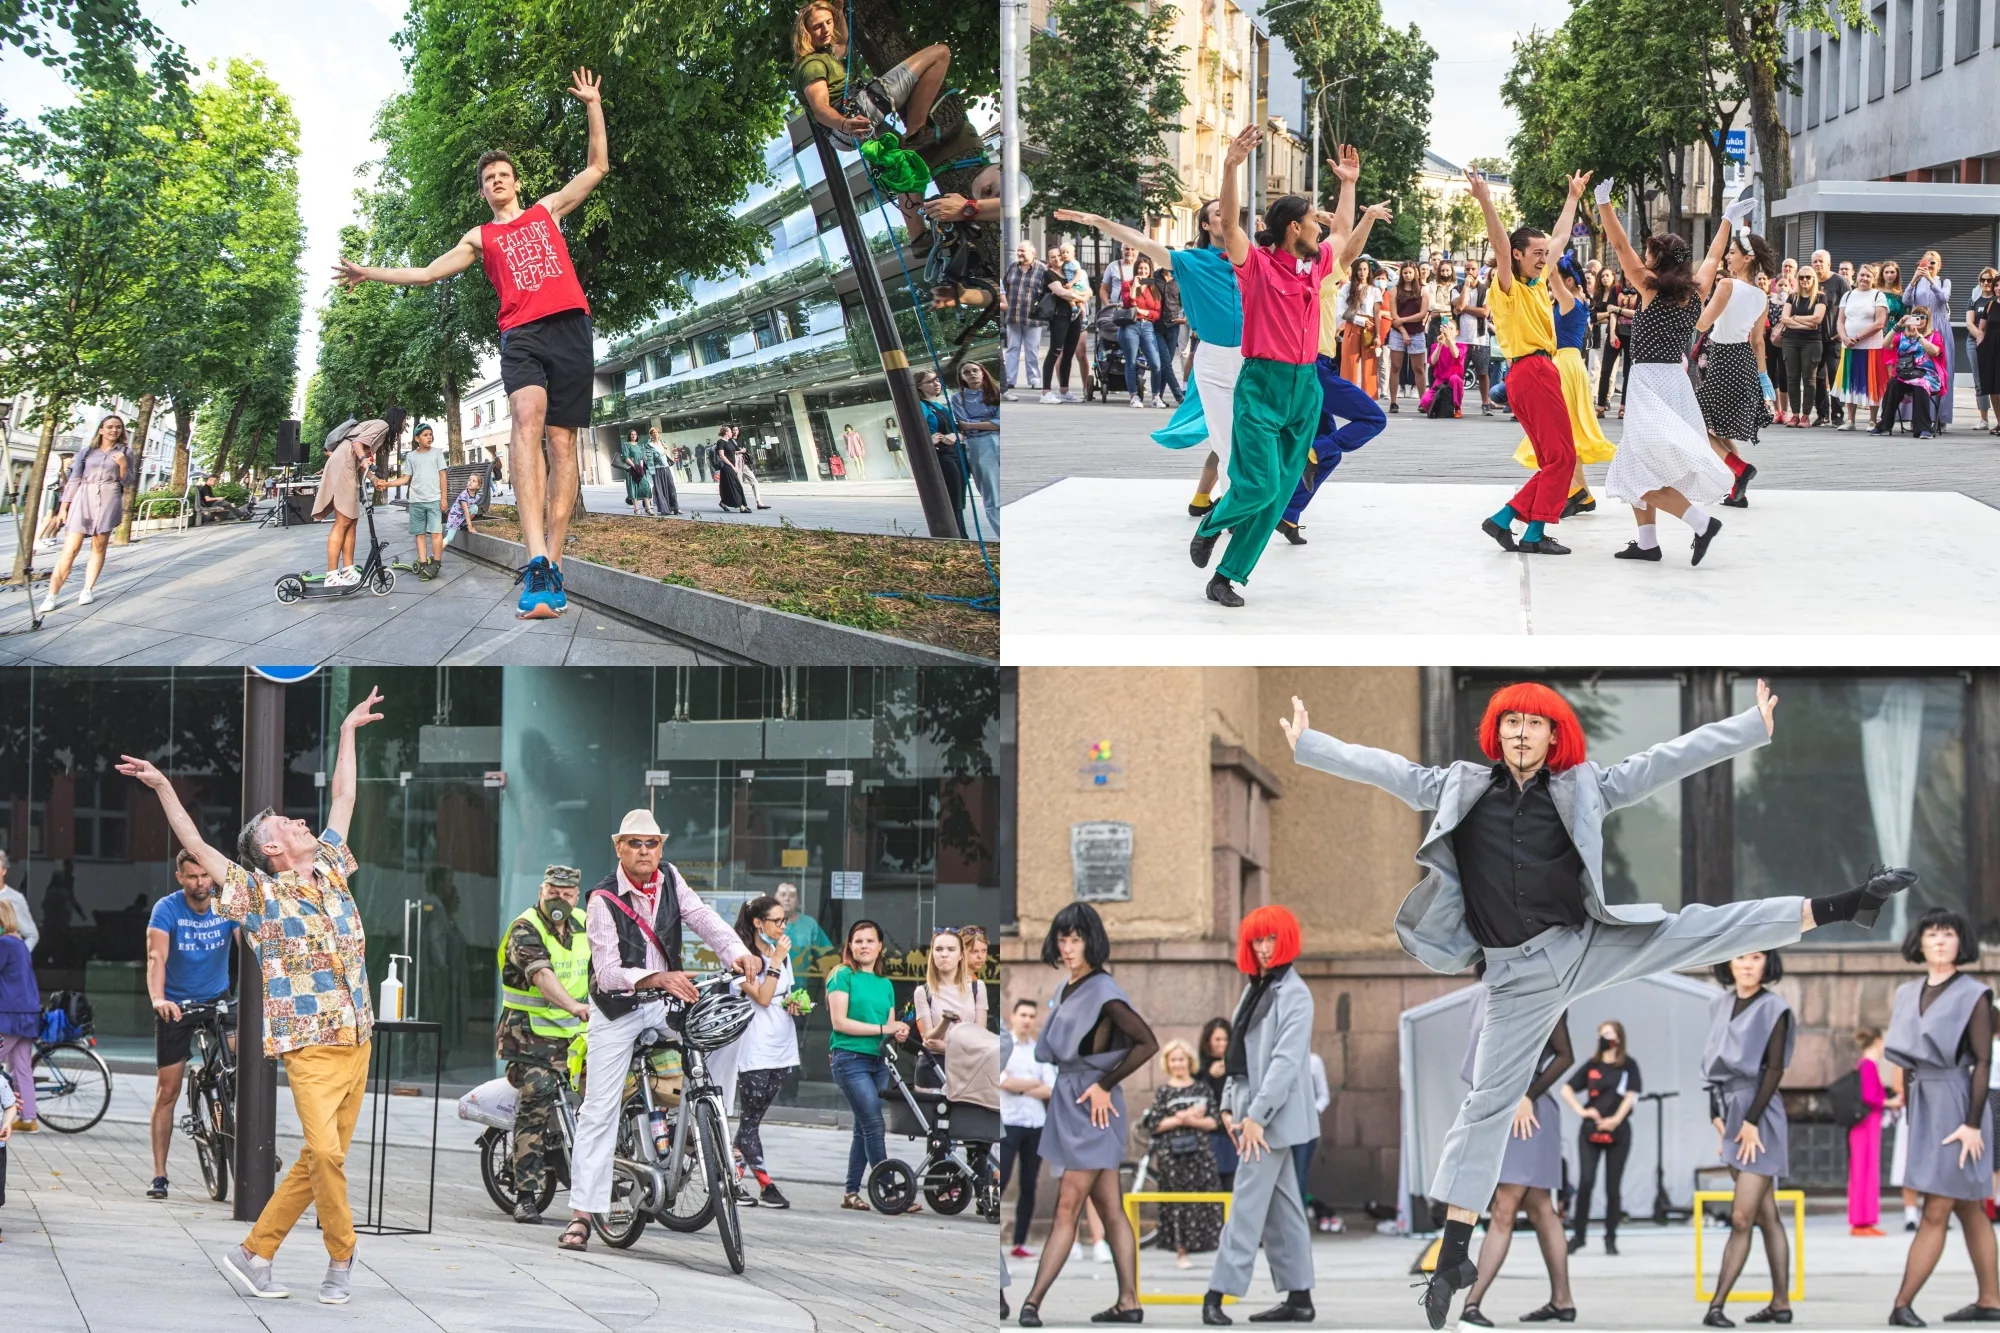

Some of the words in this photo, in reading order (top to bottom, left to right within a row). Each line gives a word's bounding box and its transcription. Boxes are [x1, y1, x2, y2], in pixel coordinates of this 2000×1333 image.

[1726, 137, 1744, 146] ukūs
[507, 243, 542, 272] SLEEP
[541, 236, 557, 255] &
[512, 255, 563, 291] REPEAT
[184, 931, 191, 939] &
[193, 930, 221, 940] FITCH
[178, 943, 200, 951] EST.
